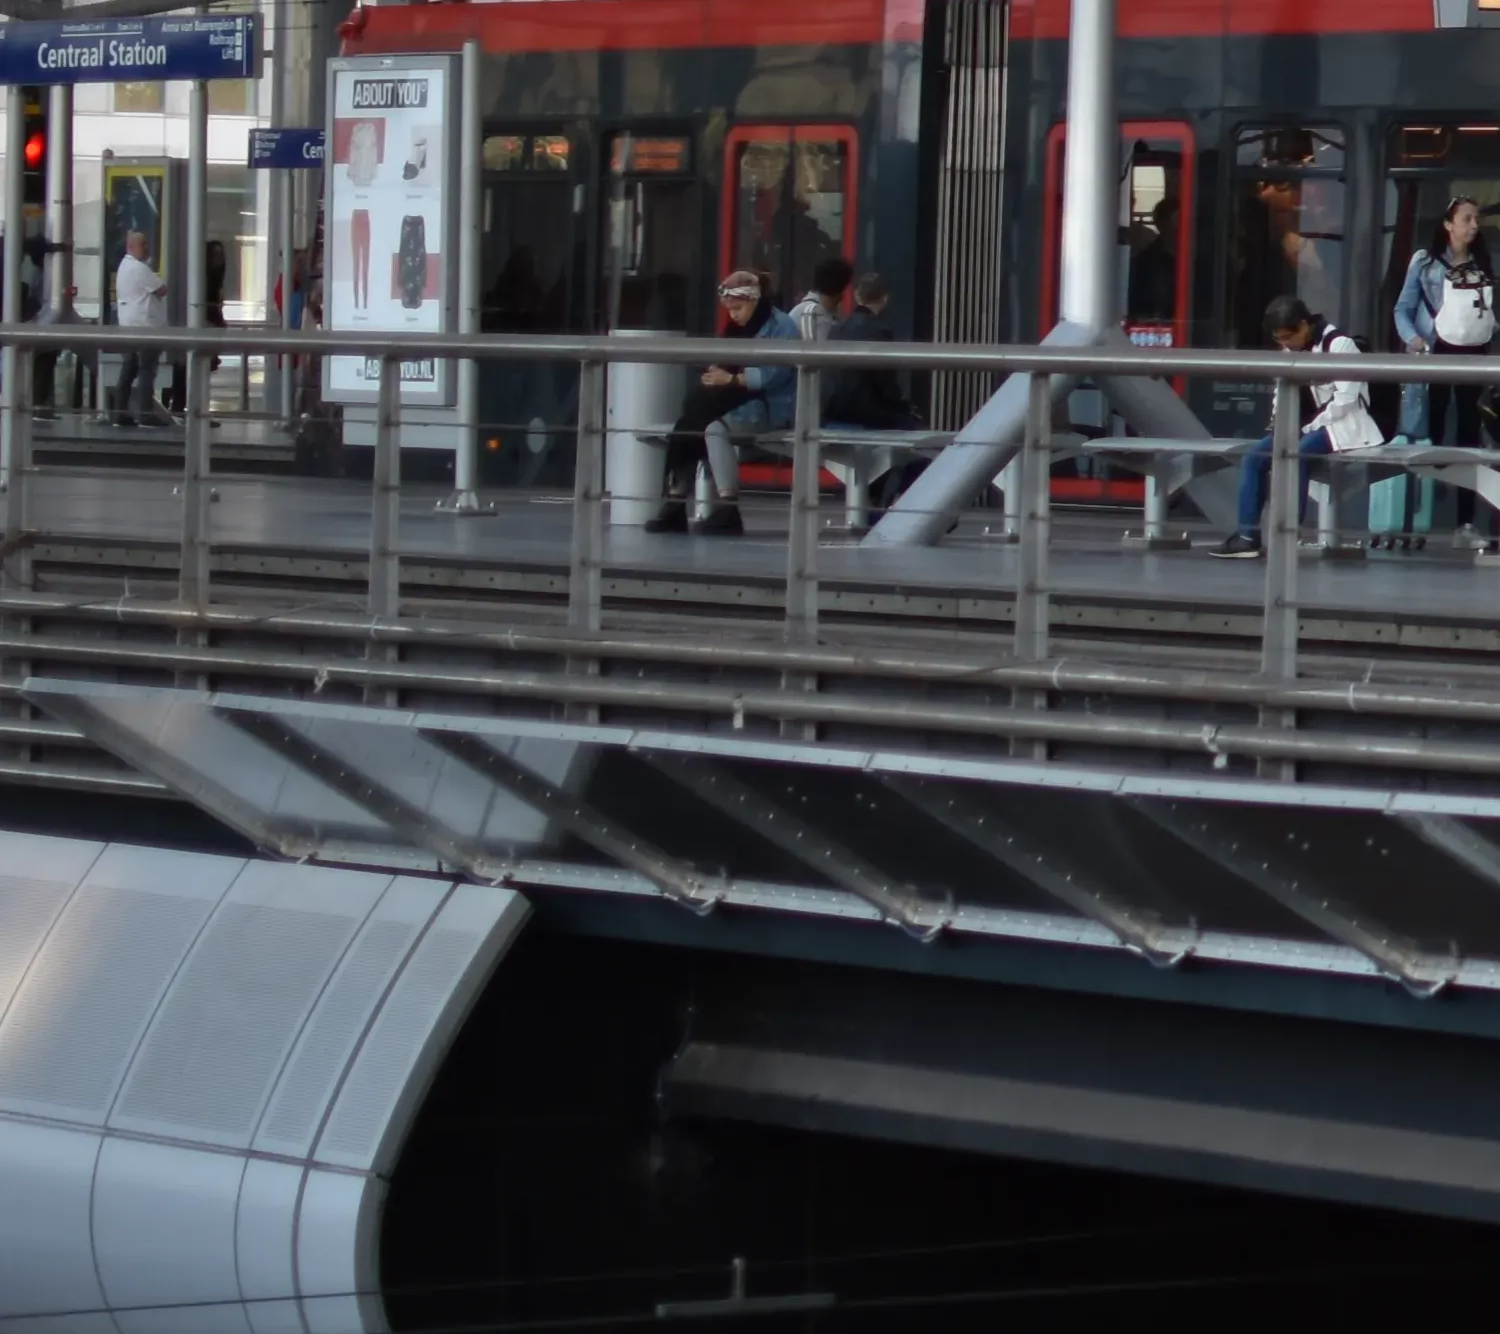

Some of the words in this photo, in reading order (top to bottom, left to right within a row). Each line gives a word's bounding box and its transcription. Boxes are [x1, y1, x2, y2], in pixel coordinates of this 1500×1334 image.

[37, 39, 103, 69] Centraal
[109, 39, 167, 67] Station
[353, 82, 394, 107] ABOUT
